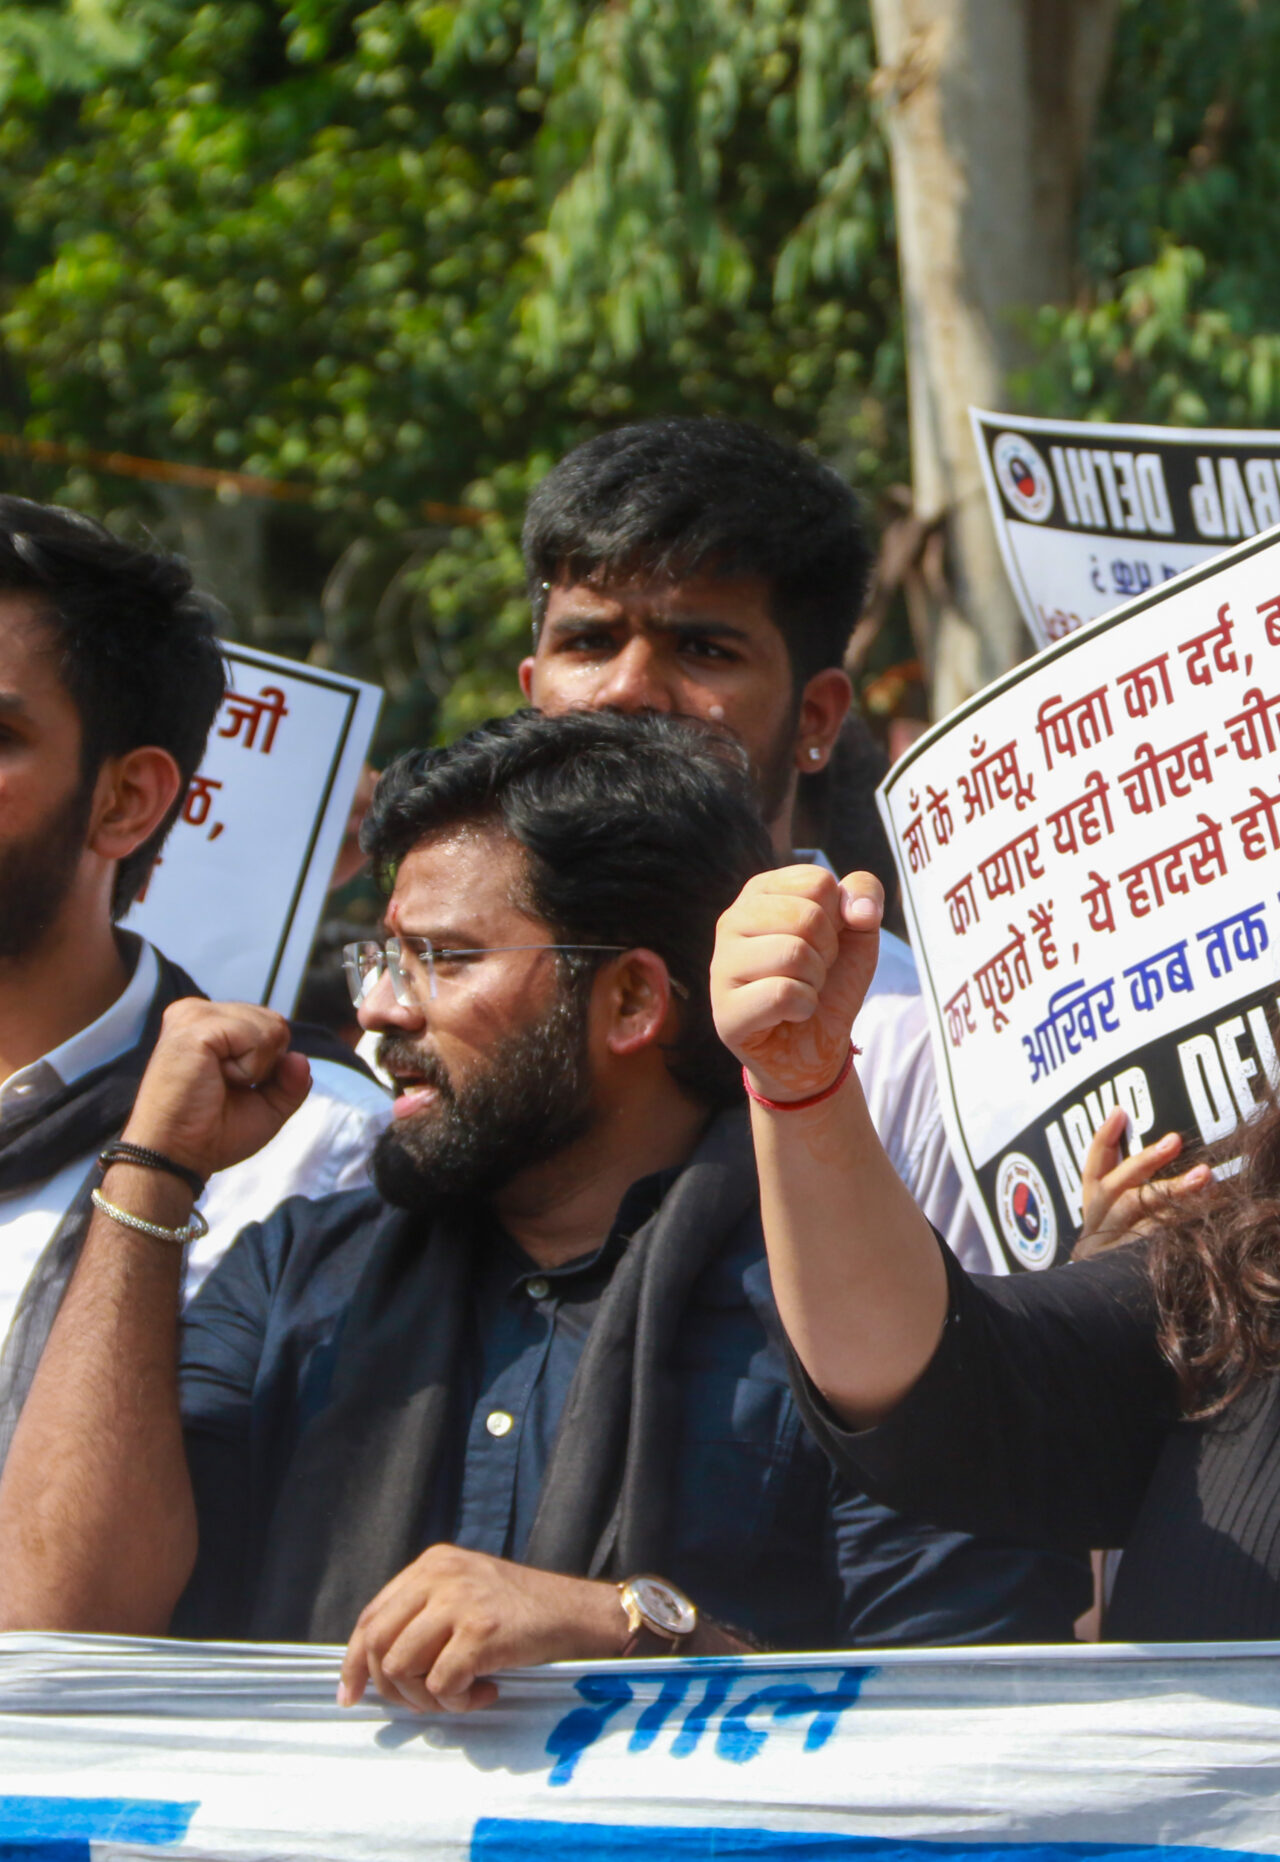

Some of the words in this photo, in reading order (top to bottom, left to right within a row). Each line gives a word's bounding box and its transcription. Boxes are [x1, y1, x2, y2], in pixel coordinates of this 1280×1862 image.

[1050, 446, 1175, 535] DELHI
[902, 788, 932, 874] माँ
[925, 785, 954, 845] के
[1035, 694, 1114, 771] पिता
[1116, 652, 1174, 718] का
[1178, 602, 1253, 686] दर्द,
[943, 980, 977, 1047] कर
[973, 923, 1033, 1033] पूछते
[1081, 871, 1116, 933] ये
[1118, 813, 1228, 918] हादसे
[944, 872, 980, 935] का
[978, 824, 1045, 900] प्यार
[1046, 770, 1115, 855] यही
[1022, 978, 1120, 1084] आखिर
[1122, 939, 1194, 1011] कब
[1196, 901, 1268, 978] तक
